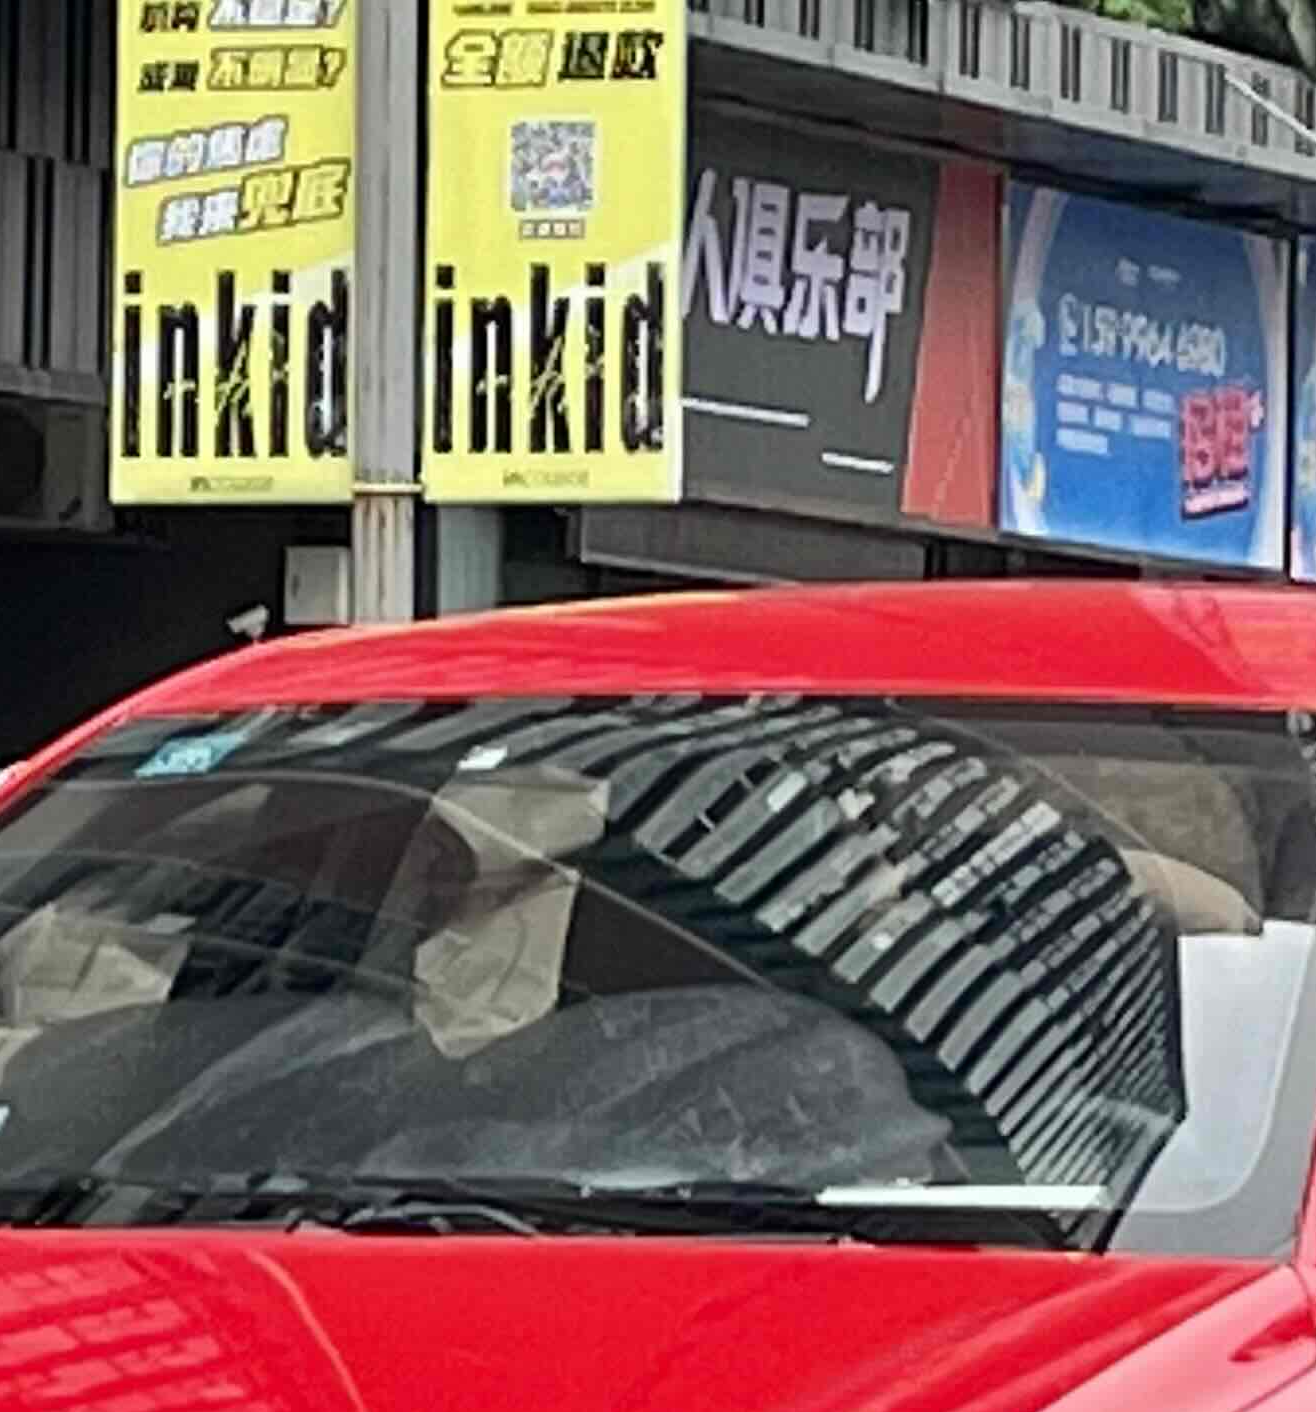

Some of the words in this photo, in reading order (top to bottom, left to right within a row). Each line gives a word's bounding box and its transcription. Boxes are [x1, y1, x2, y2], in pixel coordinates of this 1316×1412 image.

[433, 263, 664, 453] inkid
[682, 168, 911, 404] 人俱乐部
